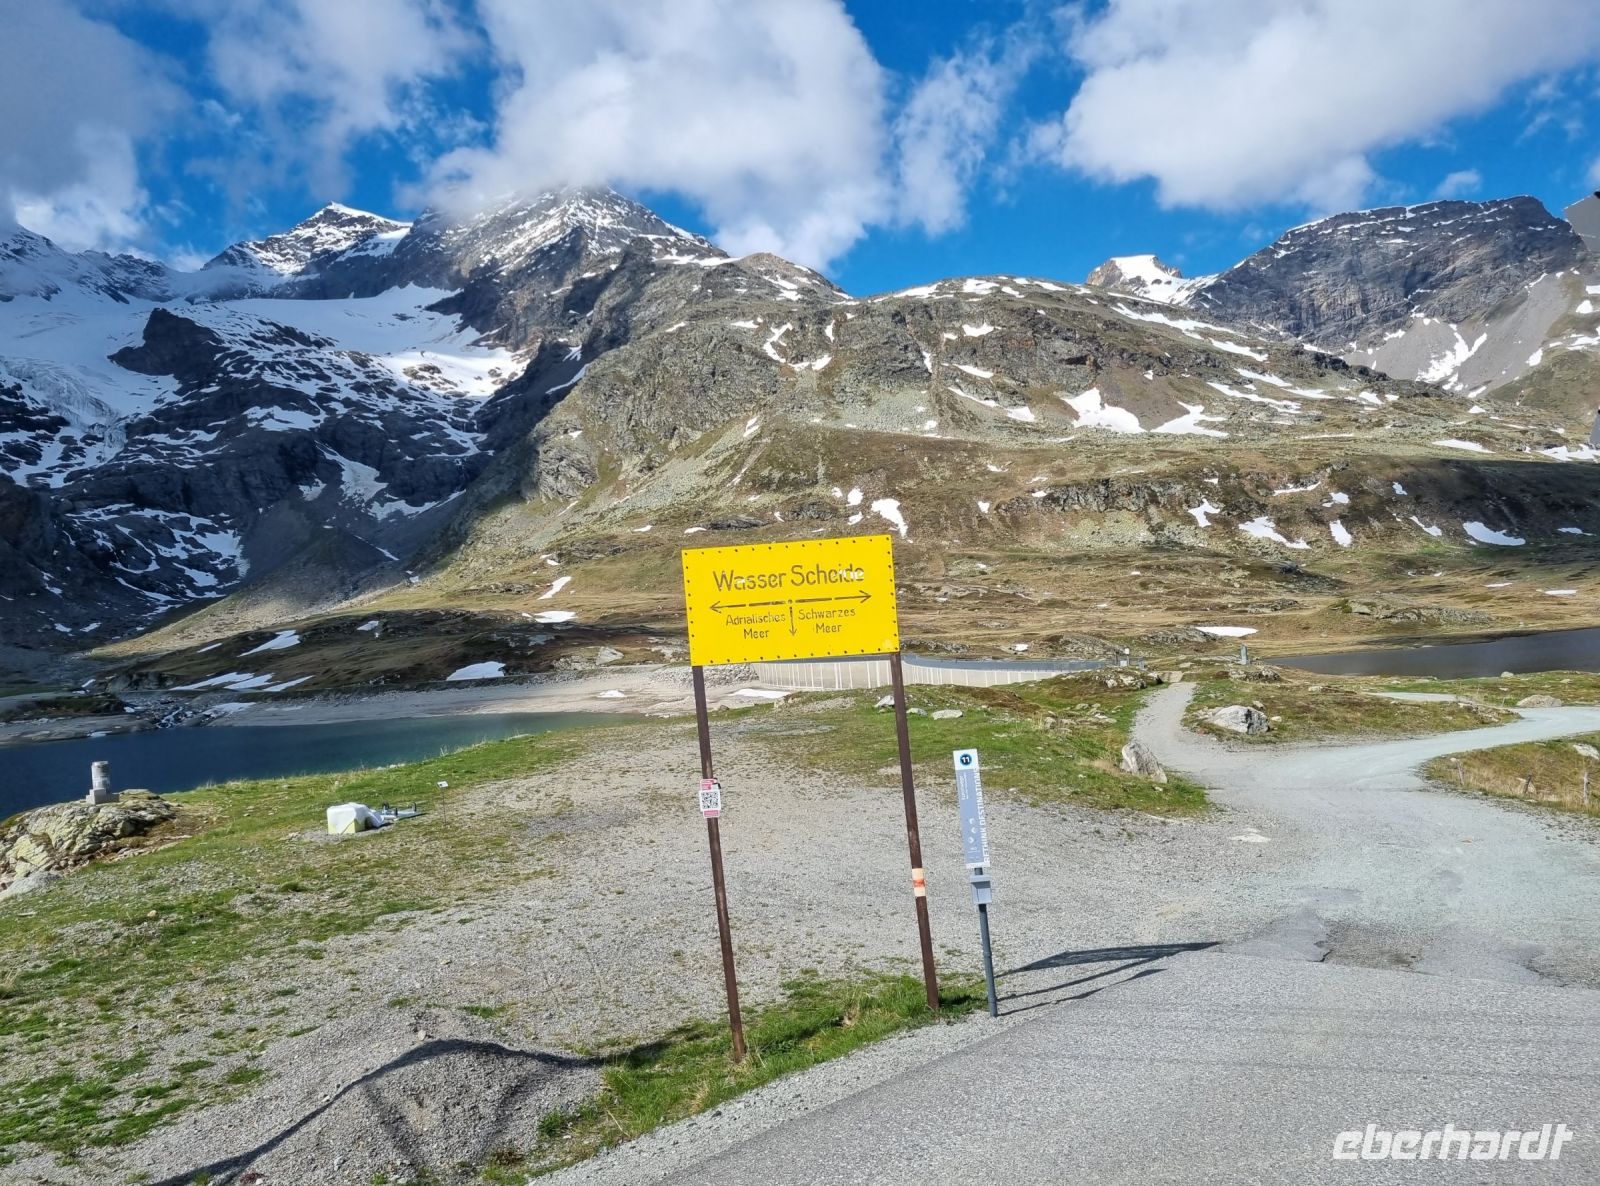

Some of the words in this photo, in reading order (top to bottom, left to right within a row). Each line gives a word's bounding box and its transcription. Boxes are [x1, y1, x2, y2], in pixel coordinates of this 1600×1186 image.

[712, 569, 786, 592] Wasser
[790, 563, 865, 587] Scheide
[798, 608, 856, 621] Schwarzes
[743, 628, 770, 640] Meer
[815, 622, 843, 634] Meer
[980, 827, 990, 863] RETHINK
